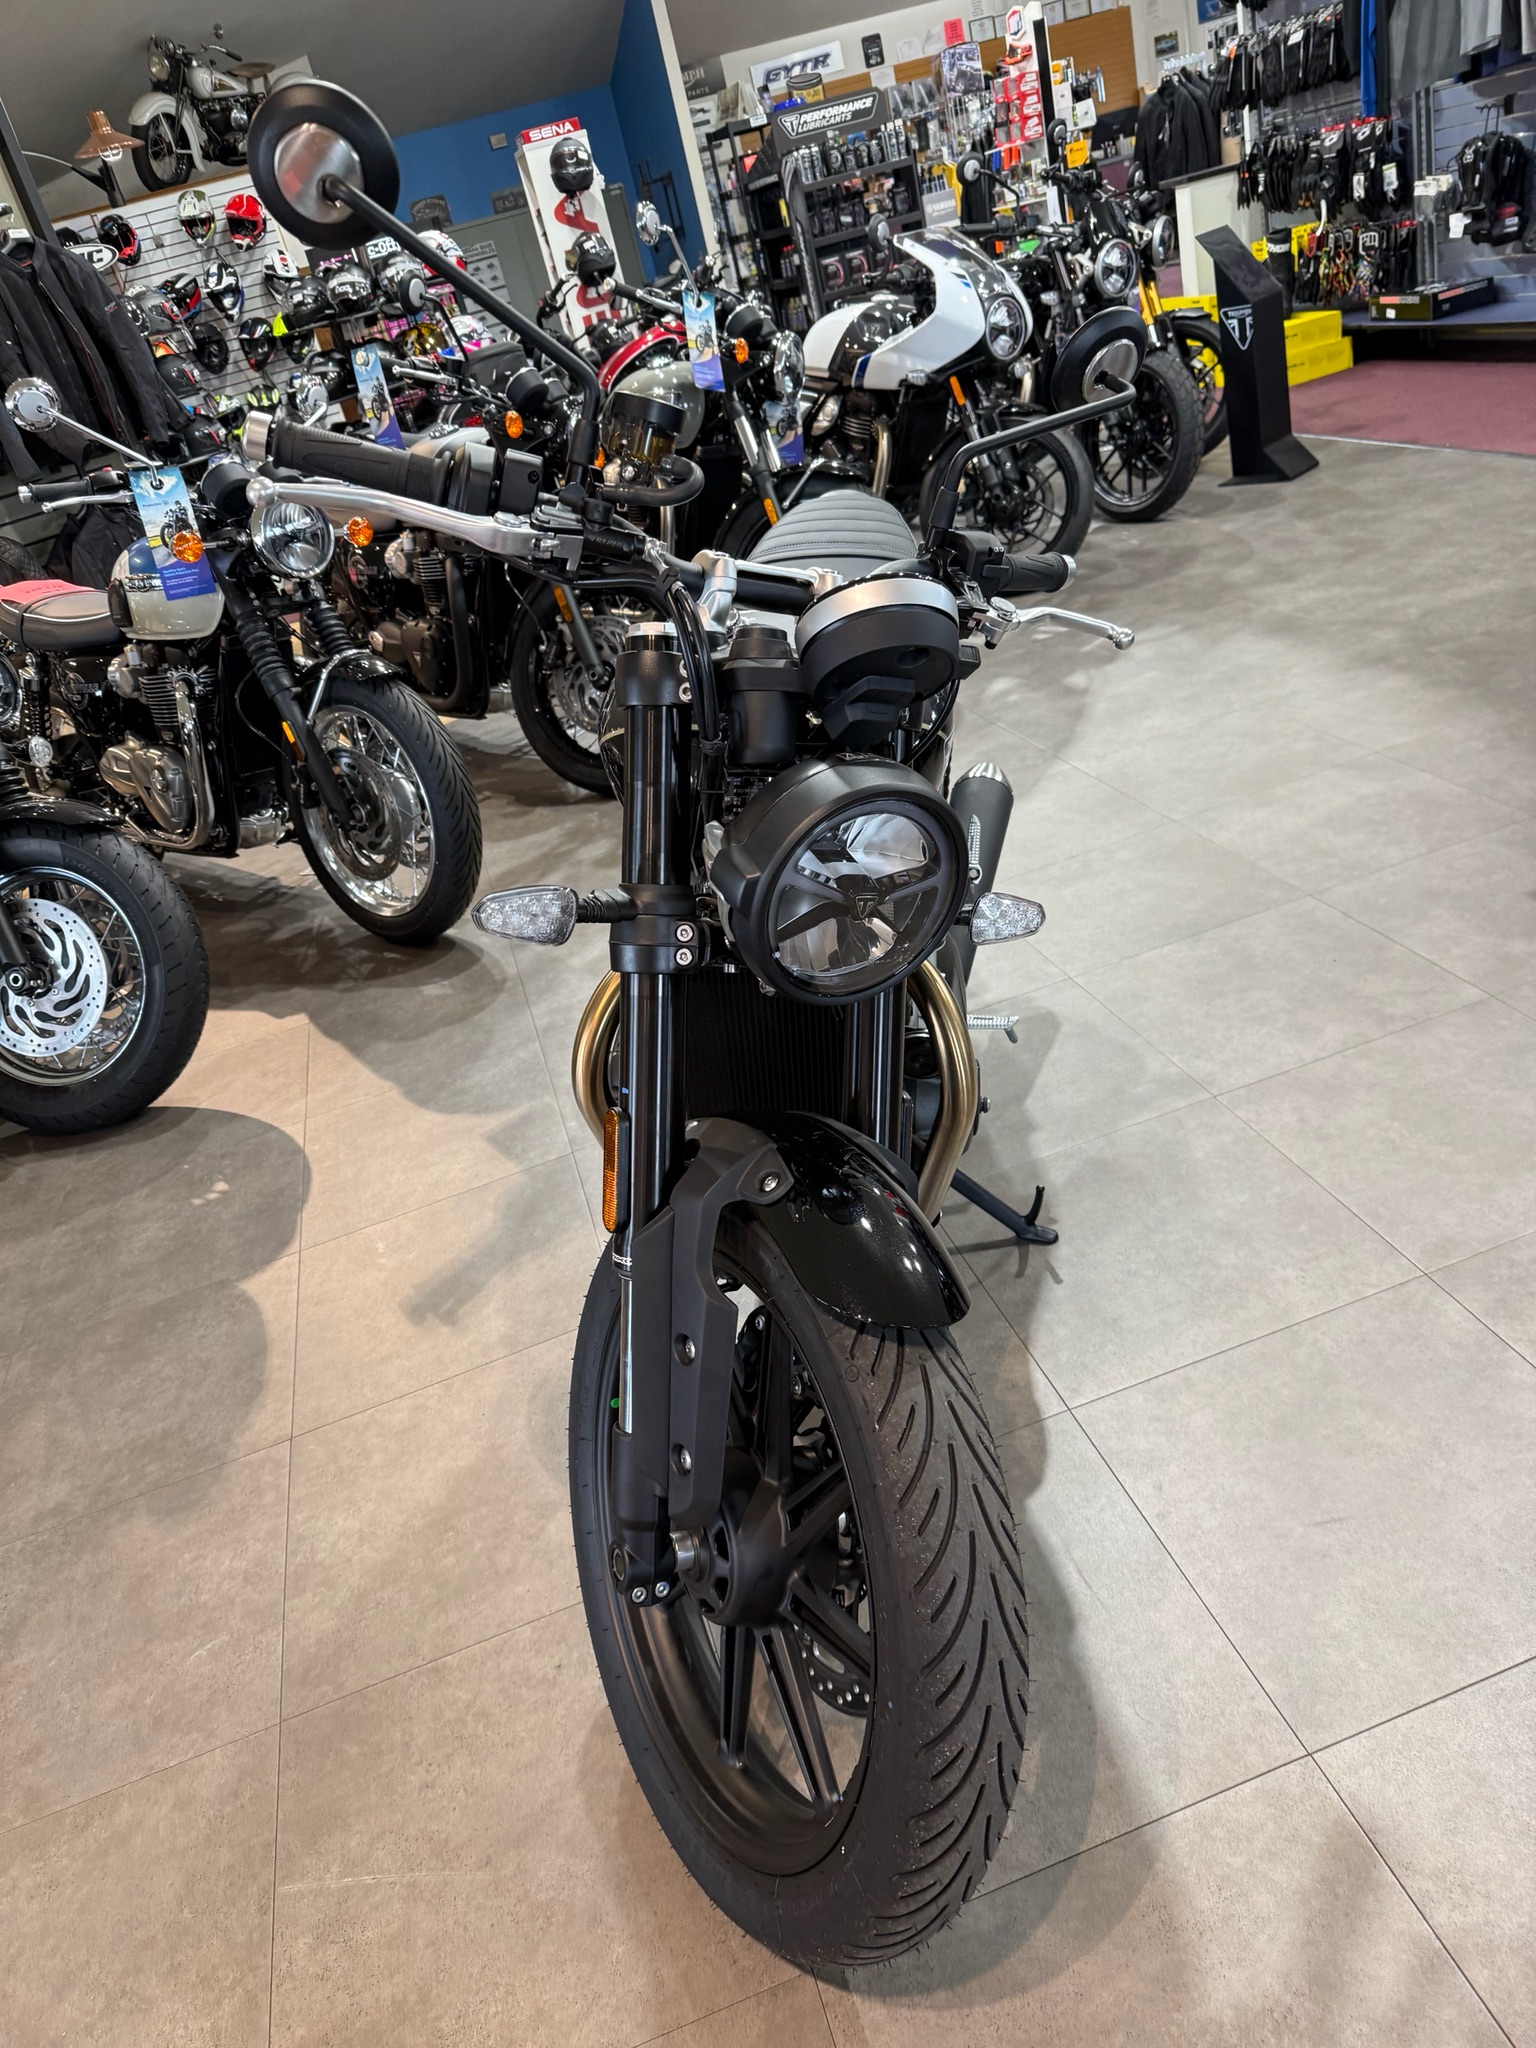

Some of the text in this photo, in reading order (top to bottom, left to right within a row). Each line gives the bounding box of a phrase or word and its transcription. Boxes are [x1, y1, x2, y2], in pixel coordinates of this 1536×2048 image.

[763, 53, 832, 84] GYTR
[687, 86, 710, 98] PARTS
[800, 96, 874, 124] PERFORMANCE
[529, 121, 574, 142] SENA
[797, 111, 853, 133] LUBRICANTS
